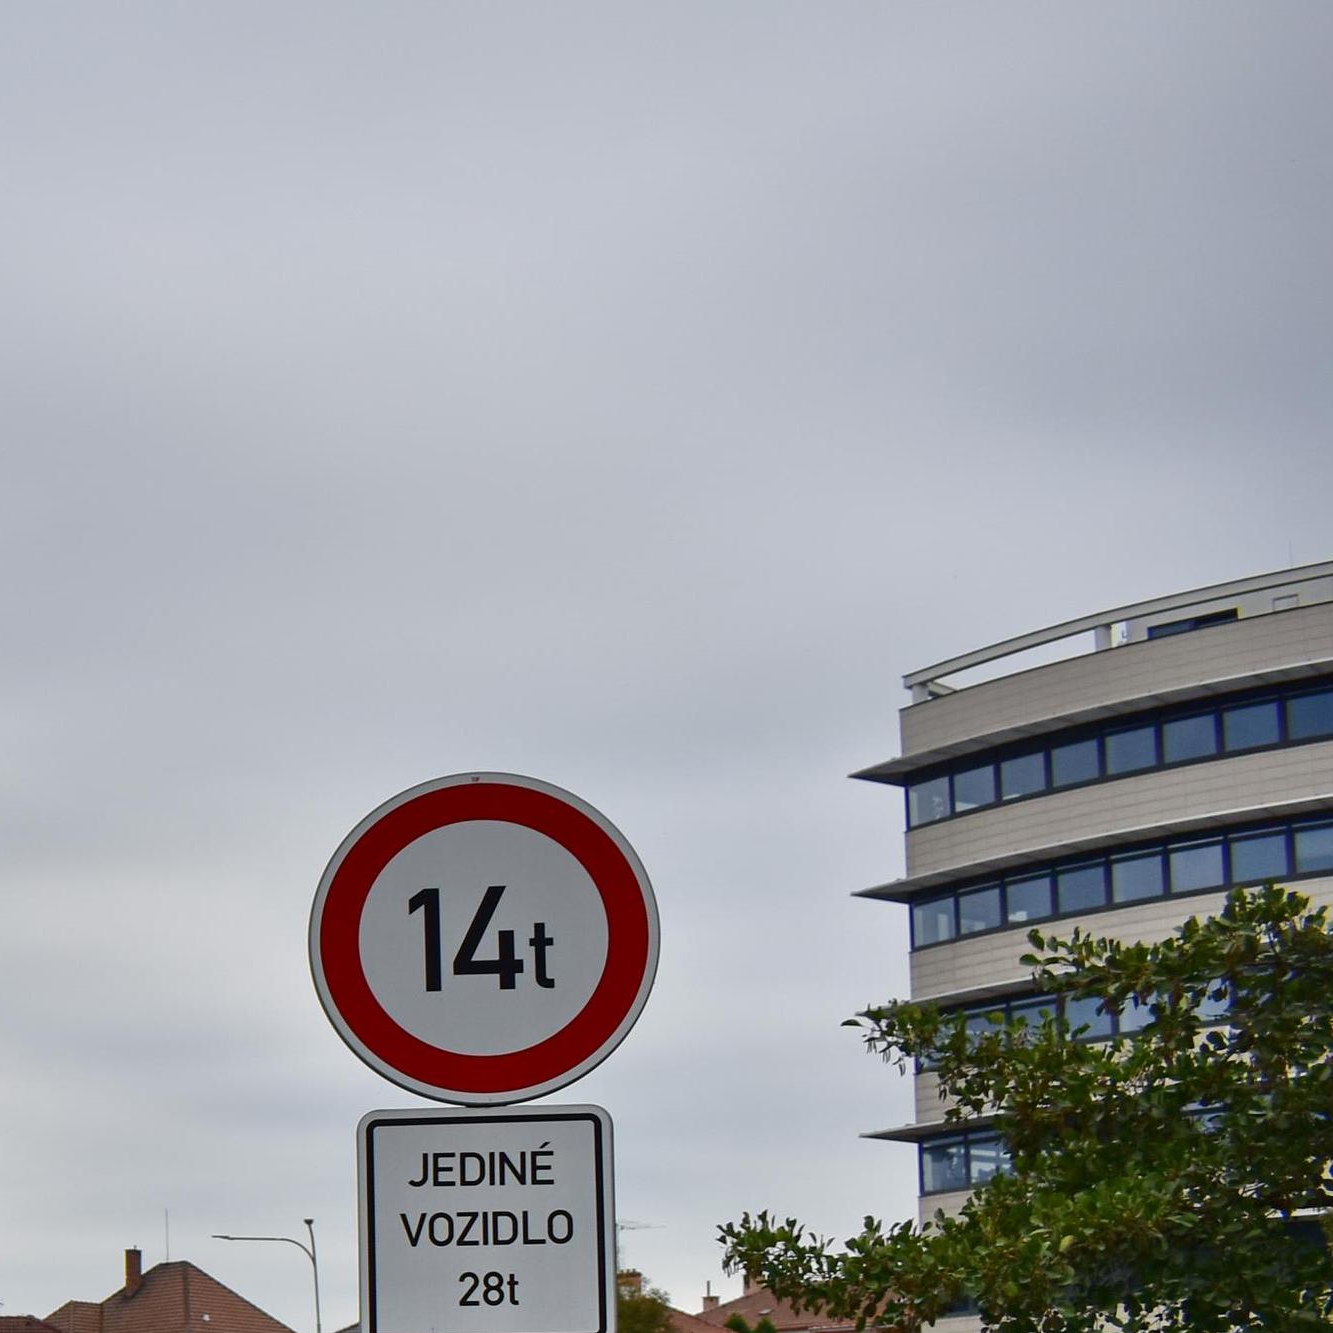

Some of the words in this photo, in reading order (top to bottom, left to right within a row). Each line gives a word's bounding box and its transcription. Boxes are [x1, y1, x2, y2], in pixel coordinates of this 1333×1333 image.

[408, 885, 556, 993] 14t
[408, 1141, 555, 1188] JEDINÉ
[399, 1209, 574, 1248] VOZIDLO
[458, 1271, 520, 1307] 28t
